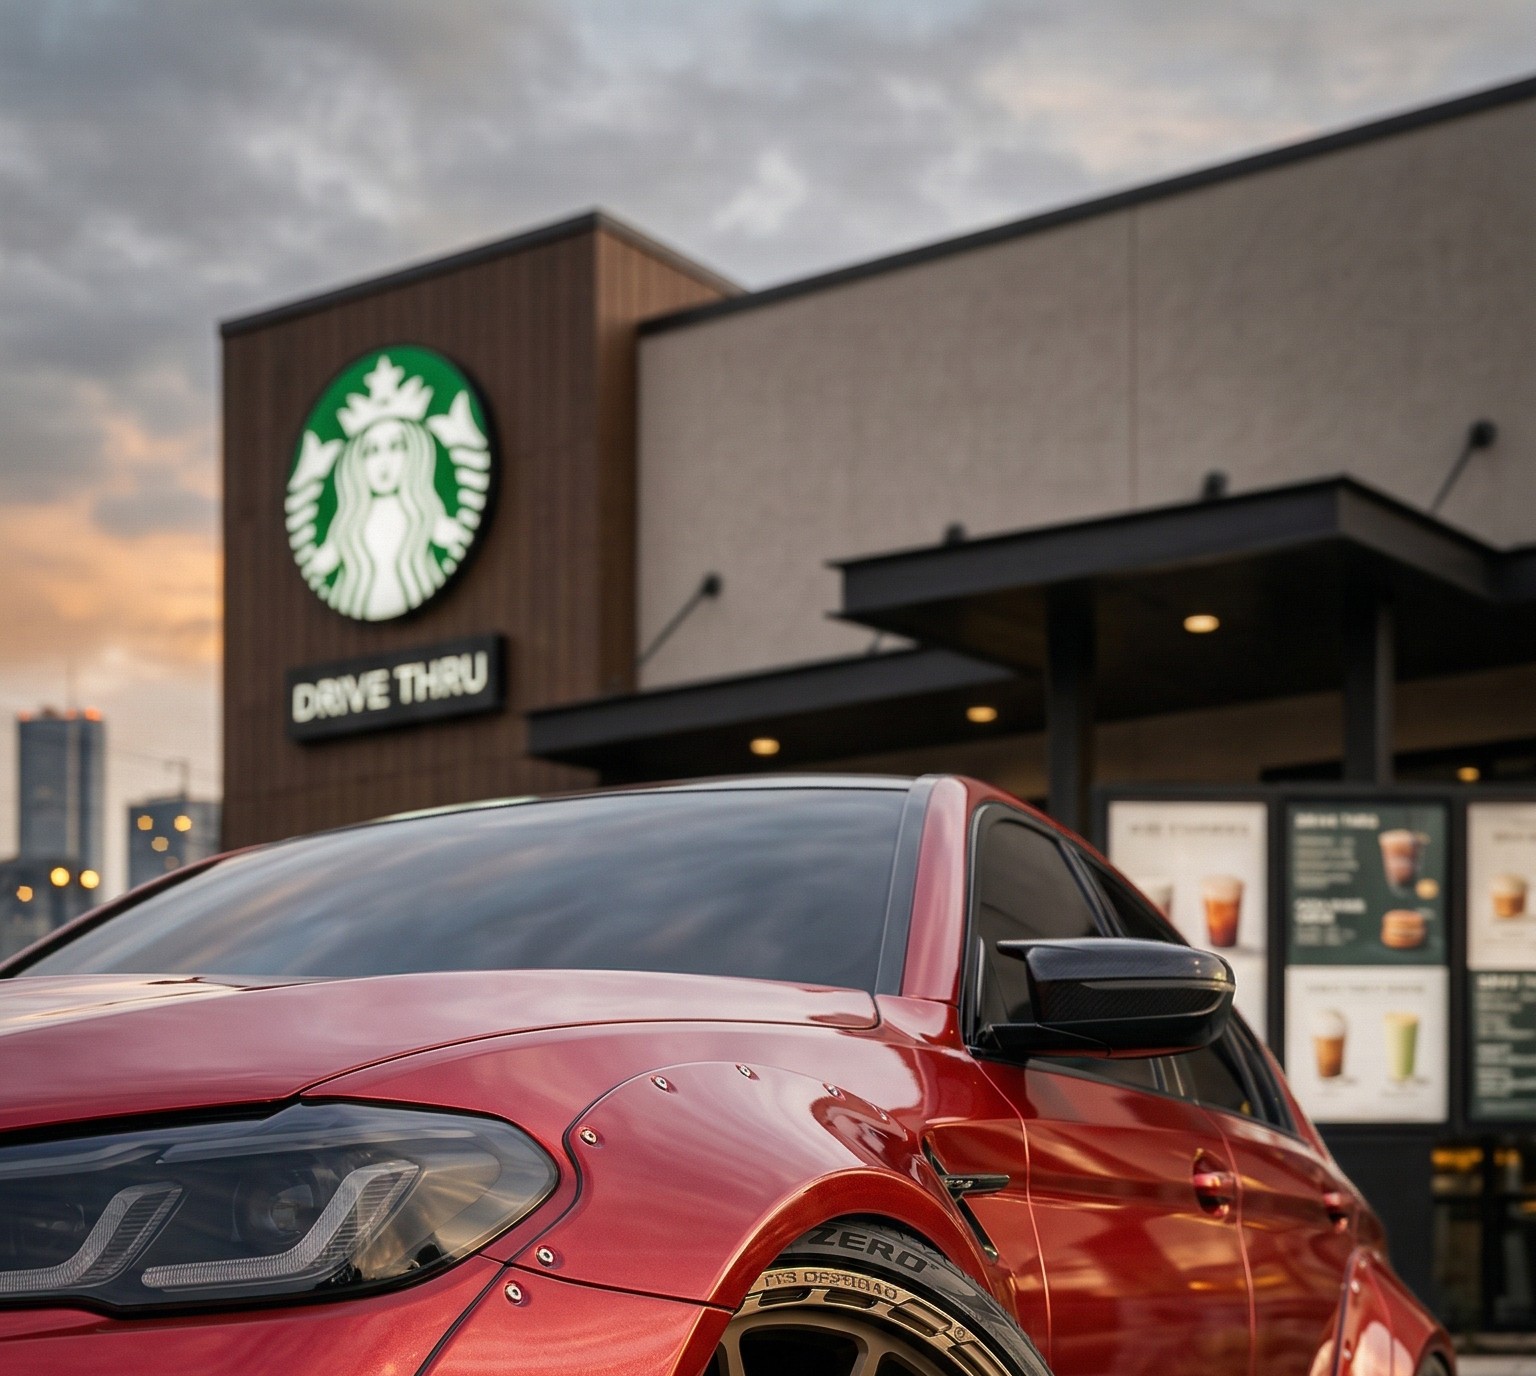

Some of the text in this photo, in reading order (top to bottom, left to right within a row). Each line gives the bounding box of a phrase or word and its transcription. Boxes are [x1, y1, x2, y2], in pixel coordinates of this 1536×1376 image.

[292, 650, 488, 724] DRIVE THRU
[807, 1228, 929, 1274] ZERO
